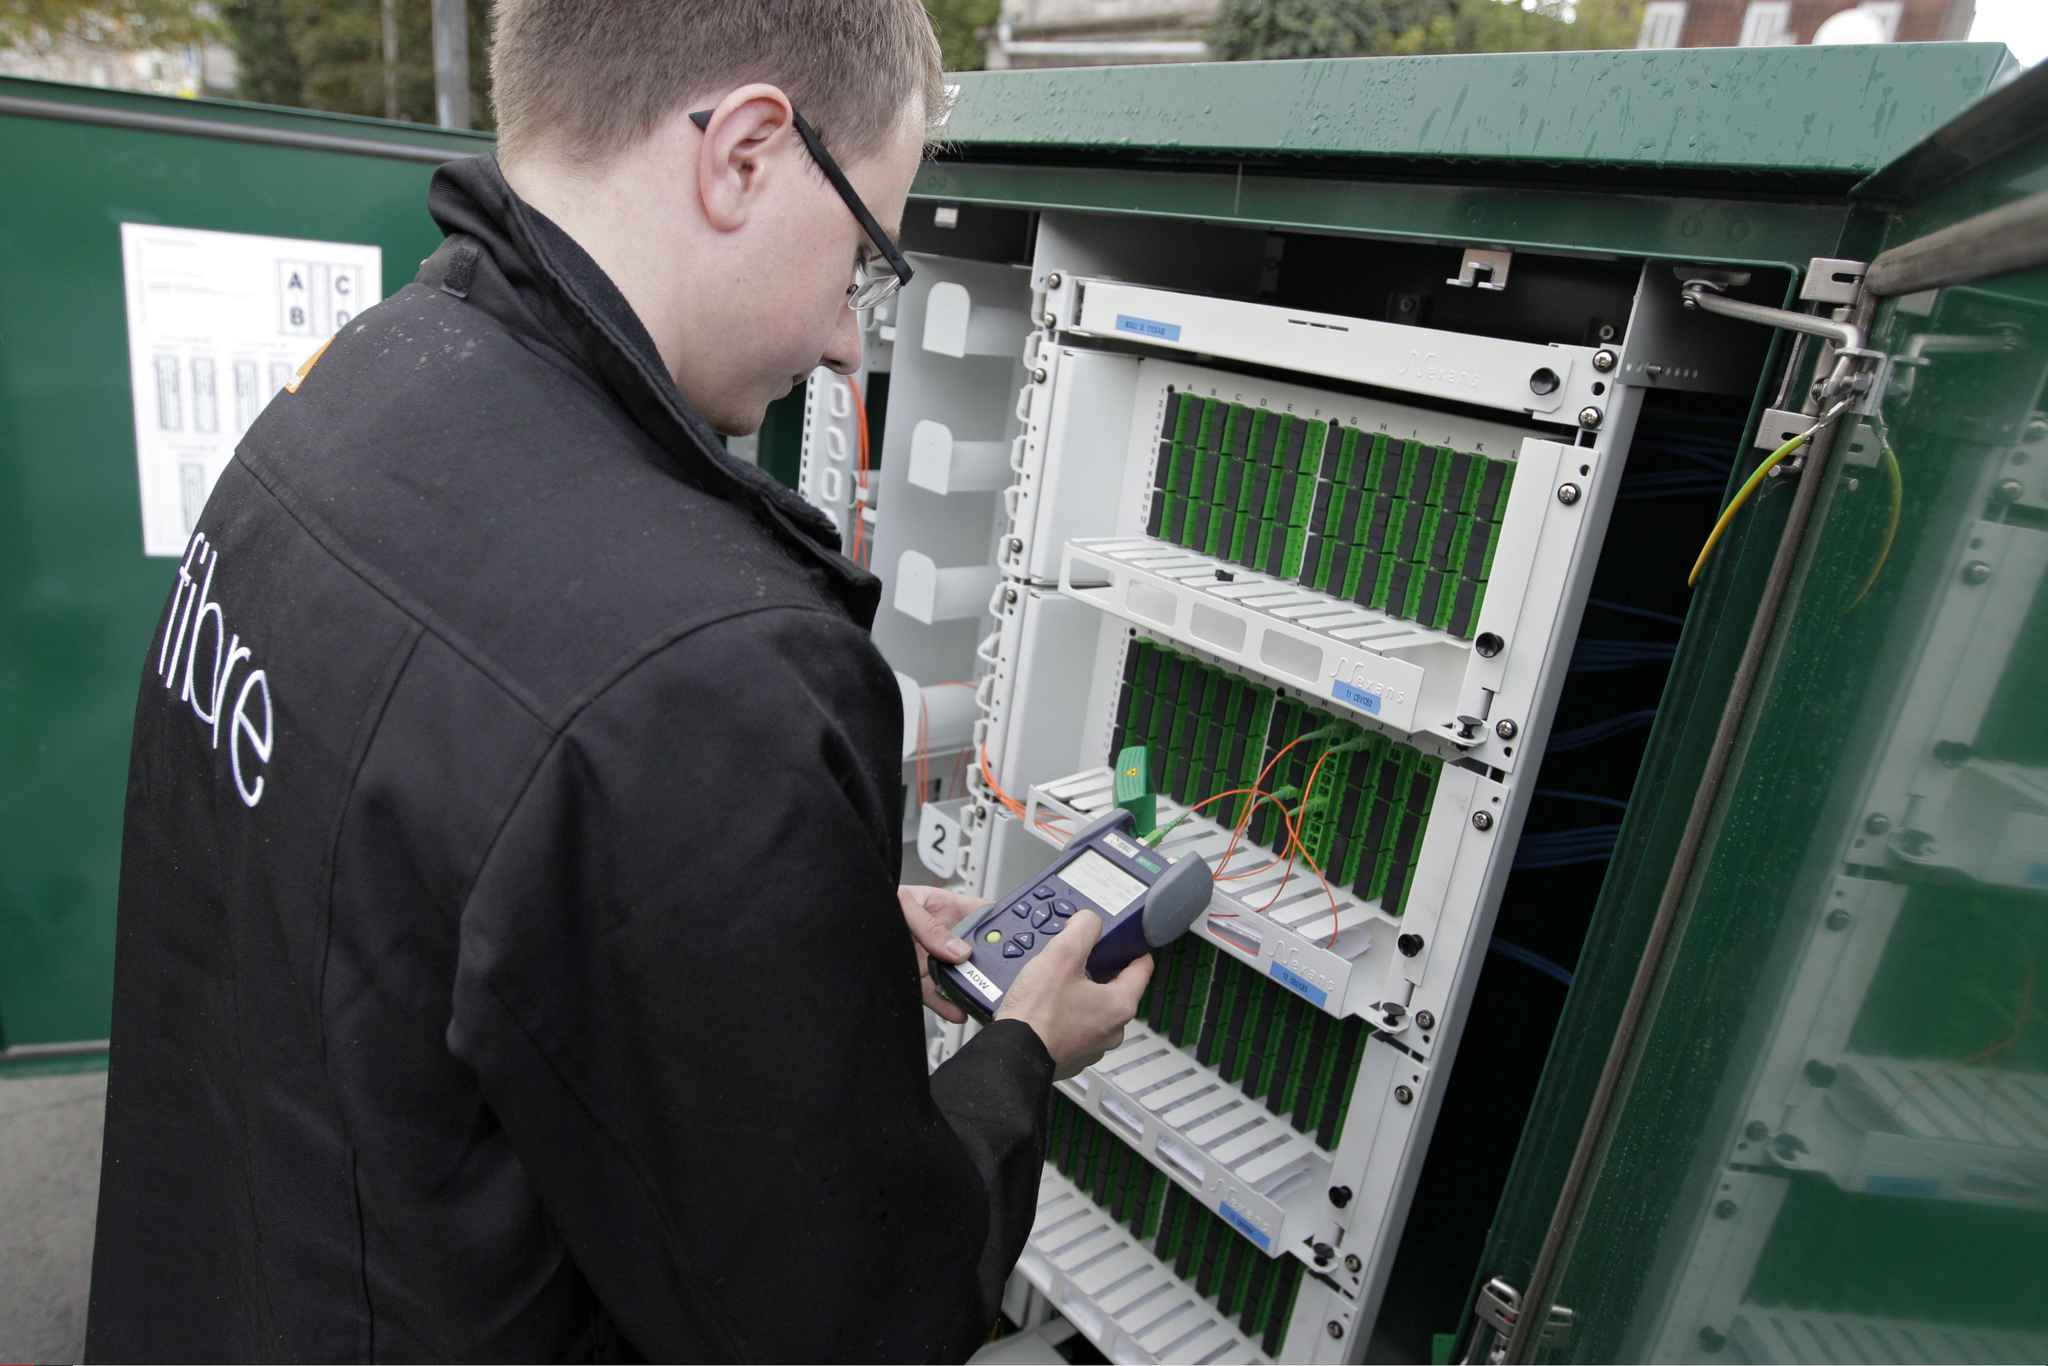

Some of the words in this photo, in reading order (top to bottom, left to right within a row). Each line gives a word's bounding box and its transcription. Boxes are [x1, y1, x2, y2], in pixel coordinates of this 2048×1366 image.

[287, 271, 304, 290] A
[335, 275, 350, 295] C
[289, 306, 305, 327] B
[158, 532, 273, 808] fibre
[931, 823, 946, 855] 2
[966, 969, 990, 991] ADW
